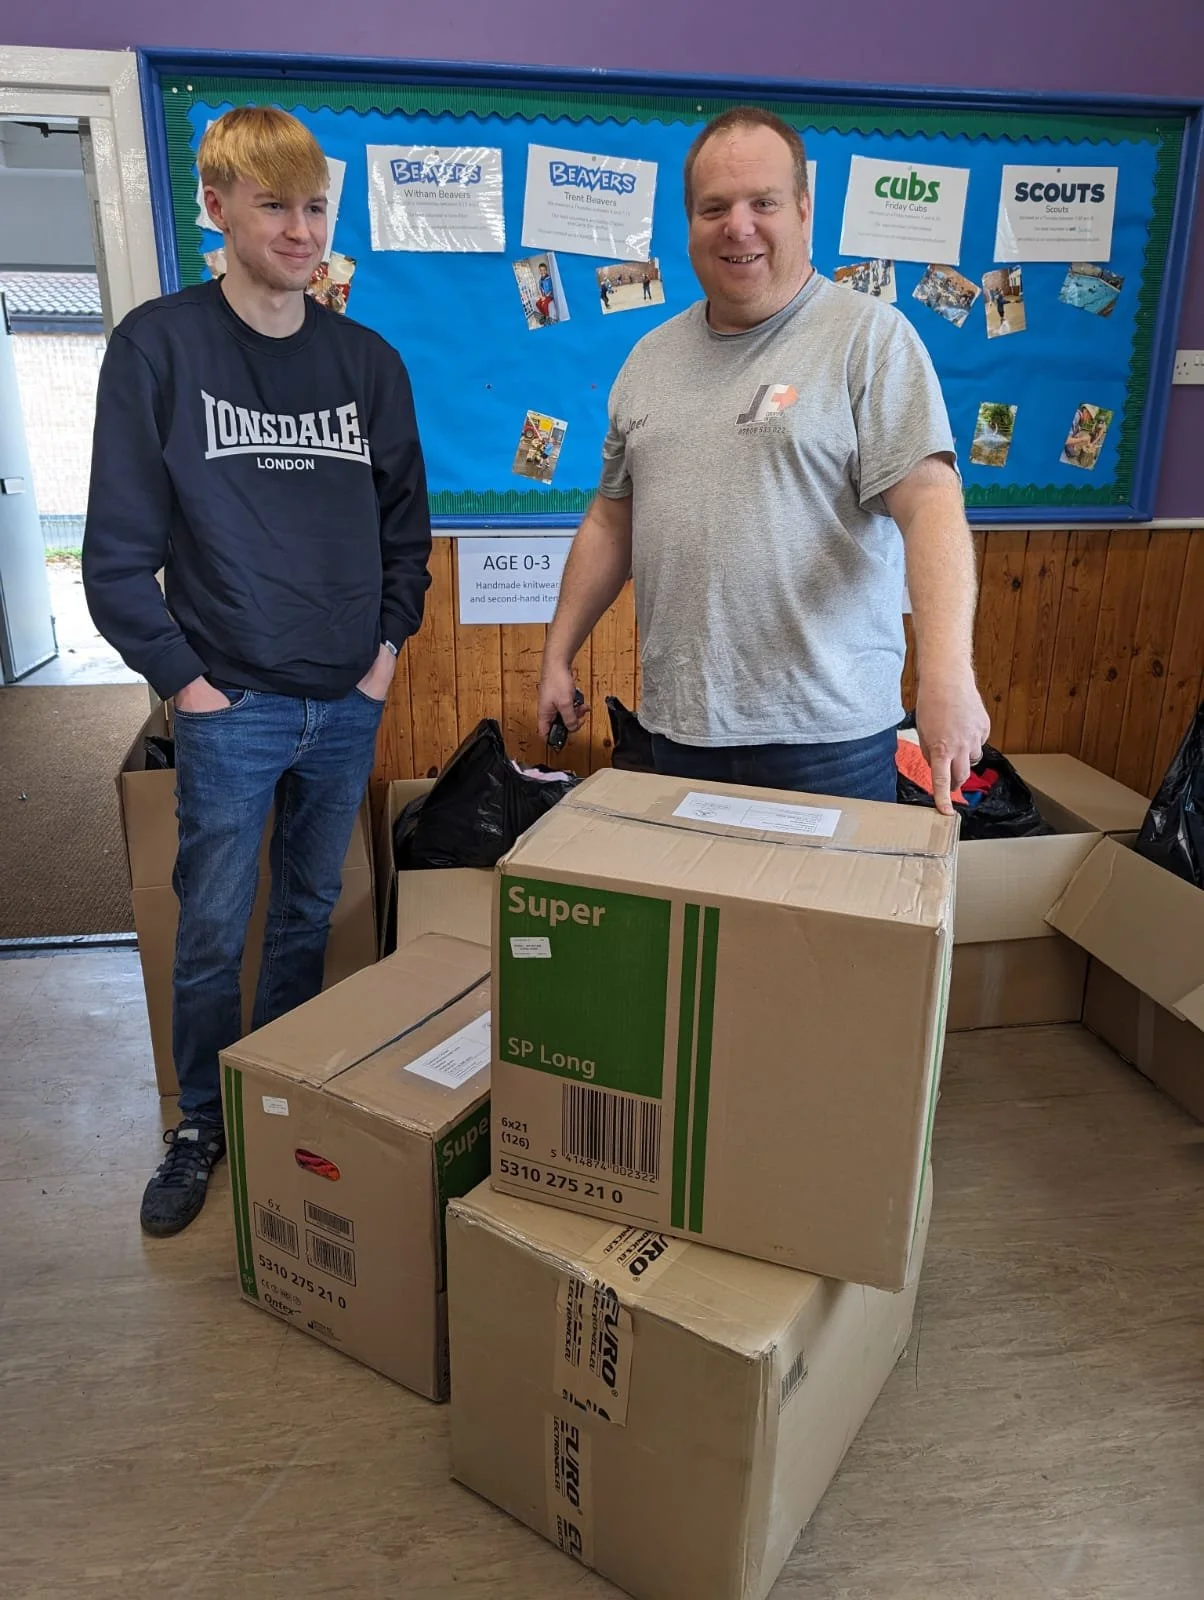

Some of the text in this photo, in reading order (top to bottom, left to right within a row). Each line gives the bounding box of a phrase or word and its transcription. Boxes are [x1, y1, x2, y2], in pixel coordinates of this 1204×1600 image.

[390, 159, 481, 186] BEAVERS
[549, 161, 636, 195] BEAVERS
[404, 189, 471, 199] Witham Beavers
[564, 191, 617, 207] Trent Beavers
[1014, 182, 1105, 203] SCOUTS
[885, 200, 928, 213] Friday Cubs
[1045, 205, 1069, 213] Scouts
[201, 389, 367, 462] LONSDALE
[257, 457, 315, 470] LONDON
[483, 554, 551, 571] AGE 0-3
[476, 580, 559, 589] Handmade knitwear
[470, 595, 485, 603] and
[487, 594, 540, 603] second-hand
[508, 886, 605, 927] Super
[508, 1037, 596, 1079] SP Long
[501, 1117, 528, 1133] 6x21
[442, 1117, 489, 1168] Supe
[501, 1131, 530, 1150] (126)
[500, 1158, 623, 1204] 5310 275 21 0
[629, 1233, 669, 1276] URO
[258, 1254, 288, 1279] 5310
[291, 1272, 314, 1293] 275
[318, 1286, 333, 1303] 21
[338, 1296, 347, 1310] 0
